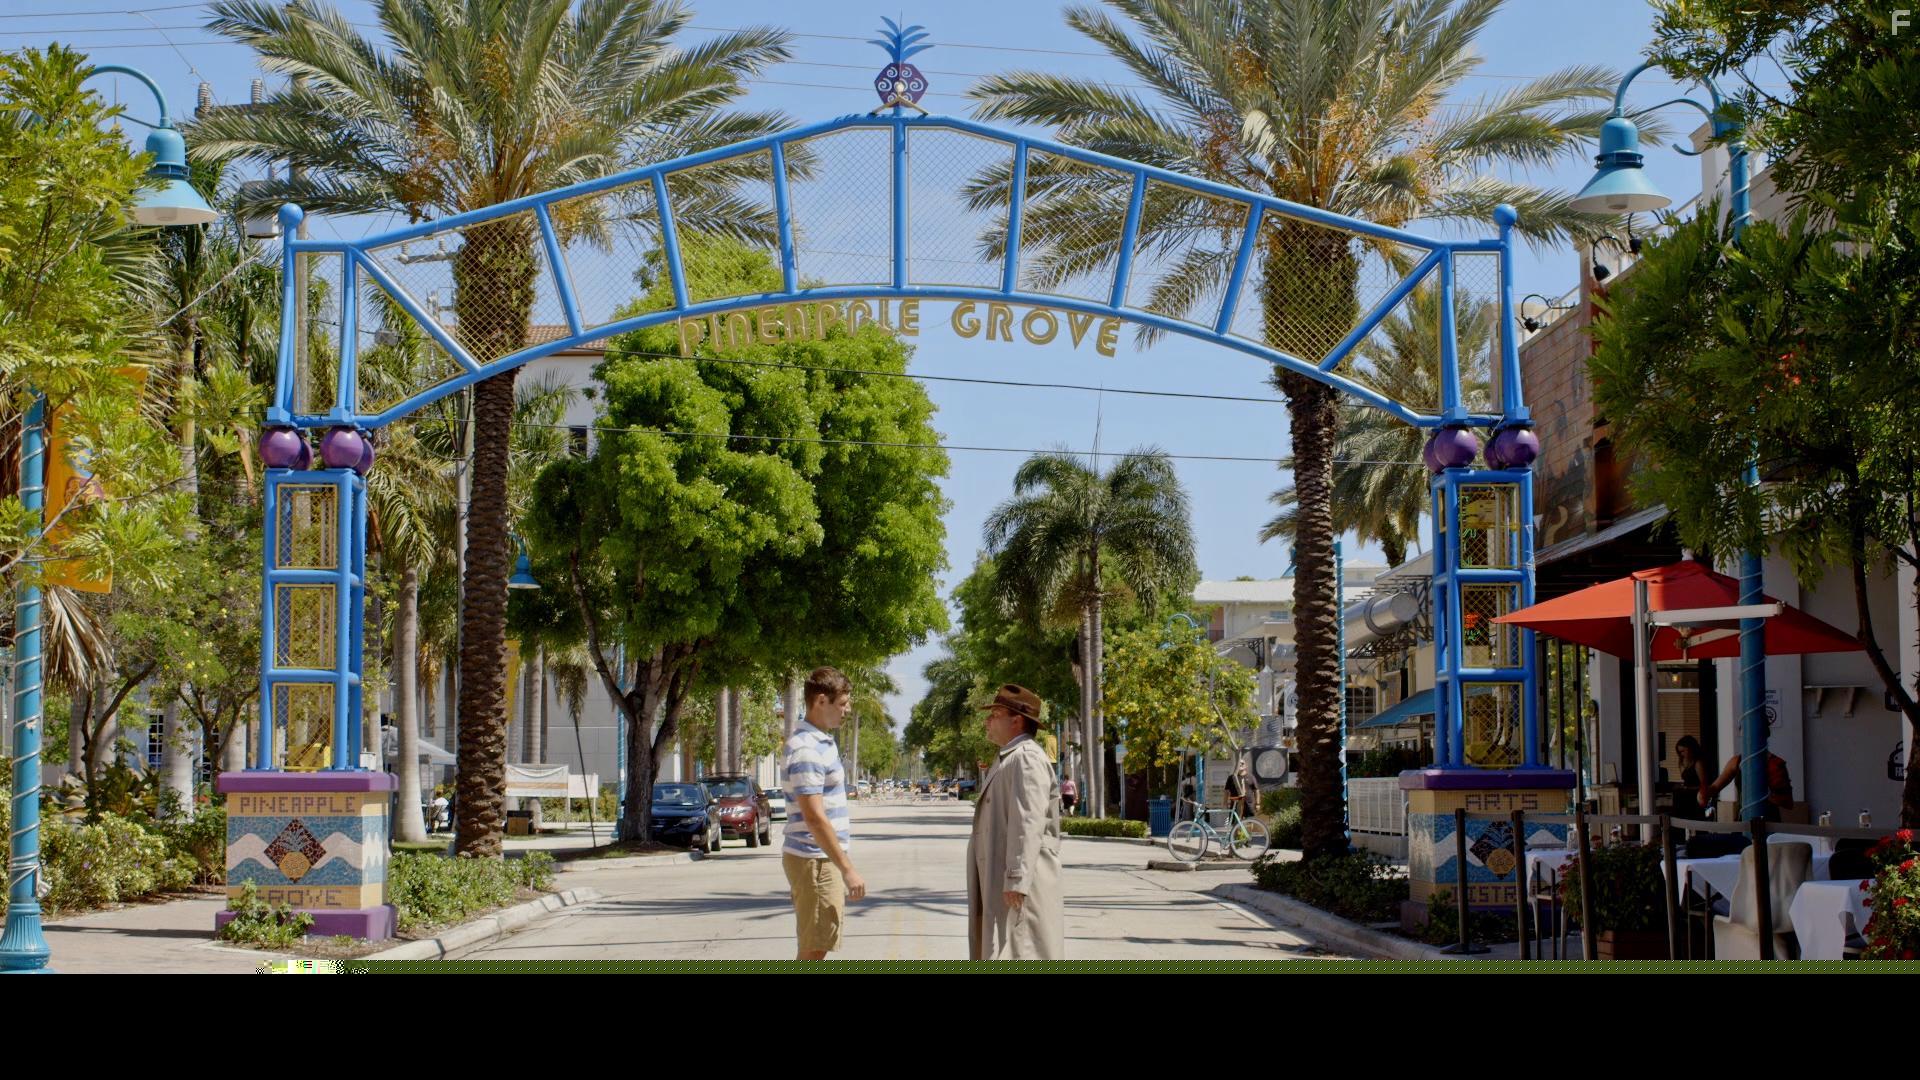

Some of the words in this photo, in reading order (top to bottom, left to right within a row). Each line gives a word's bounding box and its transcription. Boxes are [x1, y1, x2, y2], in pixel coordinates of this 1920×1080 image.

[678, 299, 920, 357] PINEAPPLE
[950, 301, 1122, 357] GROVE
[239, 796, 356, 813] PINEAPPLE
[1464, 793, 1539, 811] ARTS
